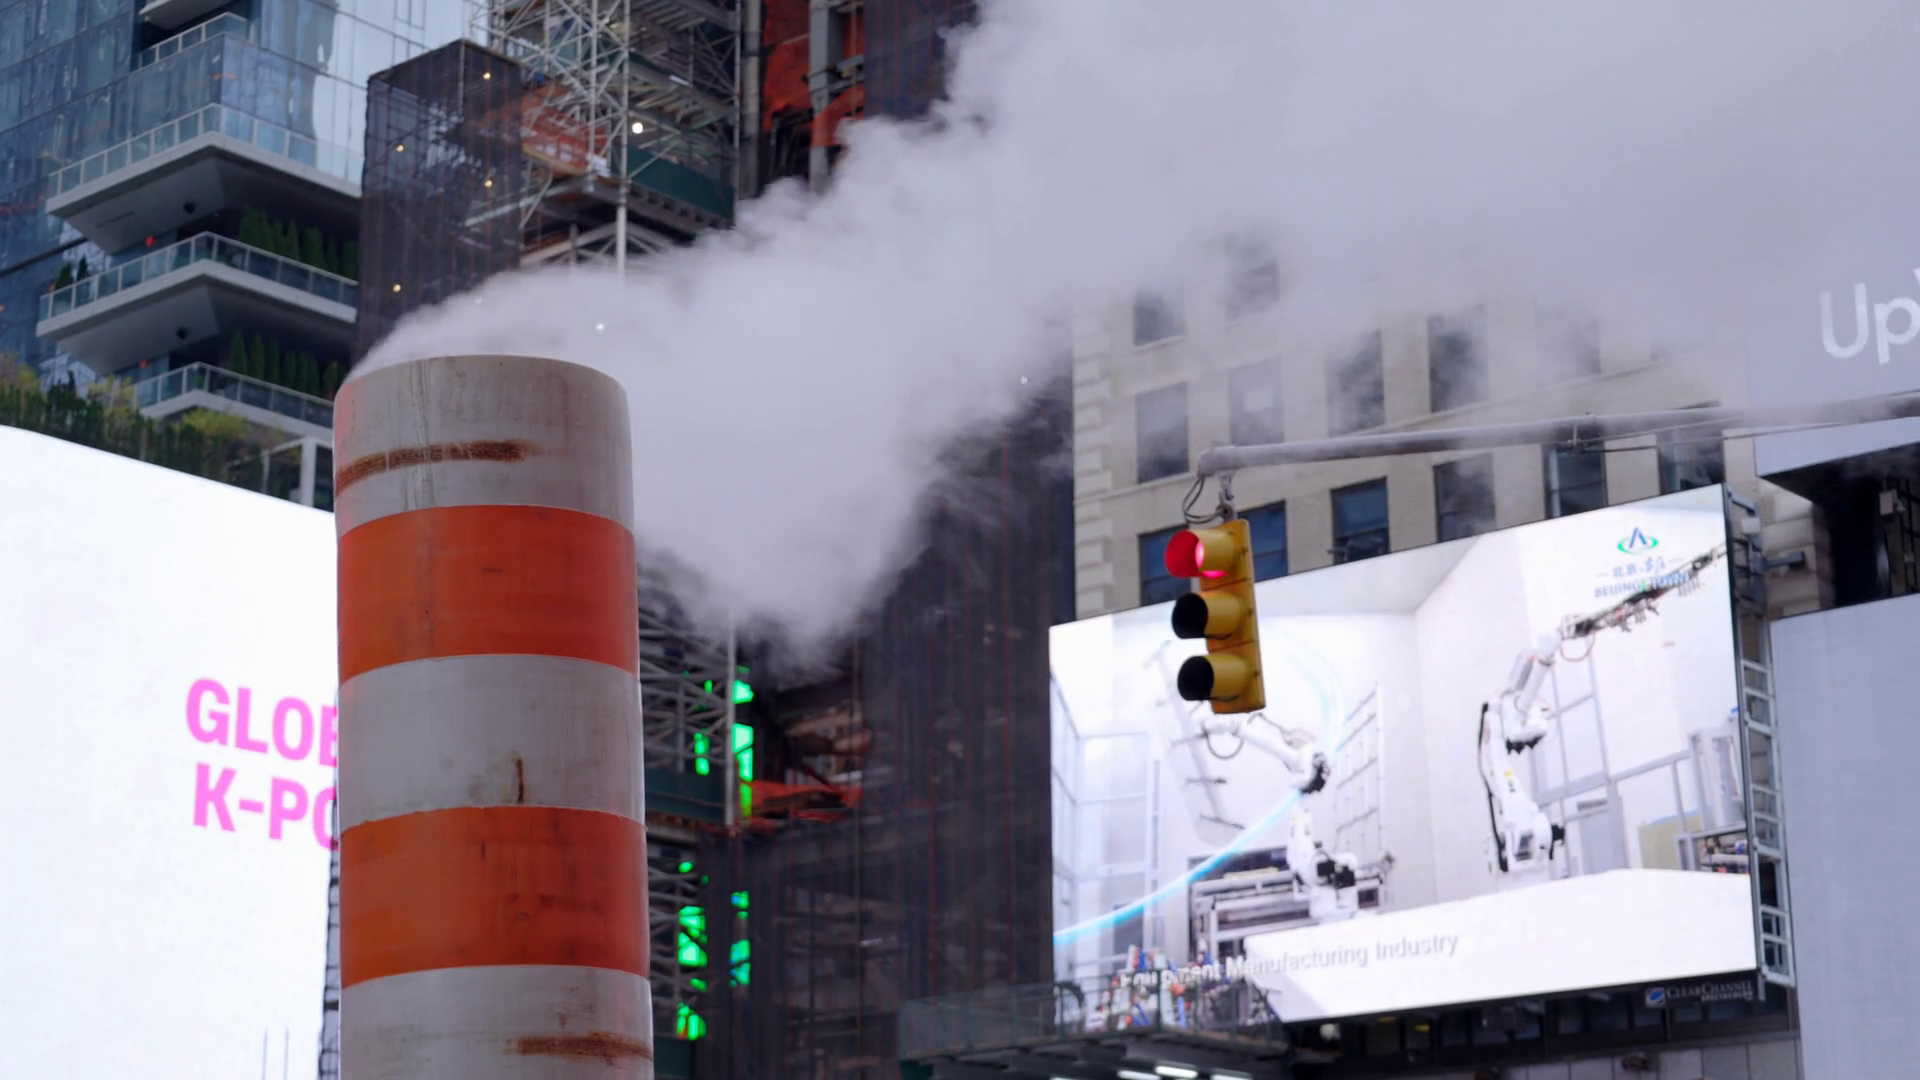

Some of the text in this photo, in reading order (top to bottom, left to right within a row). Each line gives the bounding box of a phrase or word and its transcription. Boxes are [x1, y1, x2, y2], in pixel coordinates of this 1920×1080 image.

[1820, 268, 1920, 365] Up
[1225, 944, 1368, 980] Manufacturing
[1376, 934, 1459, 960] Industry
